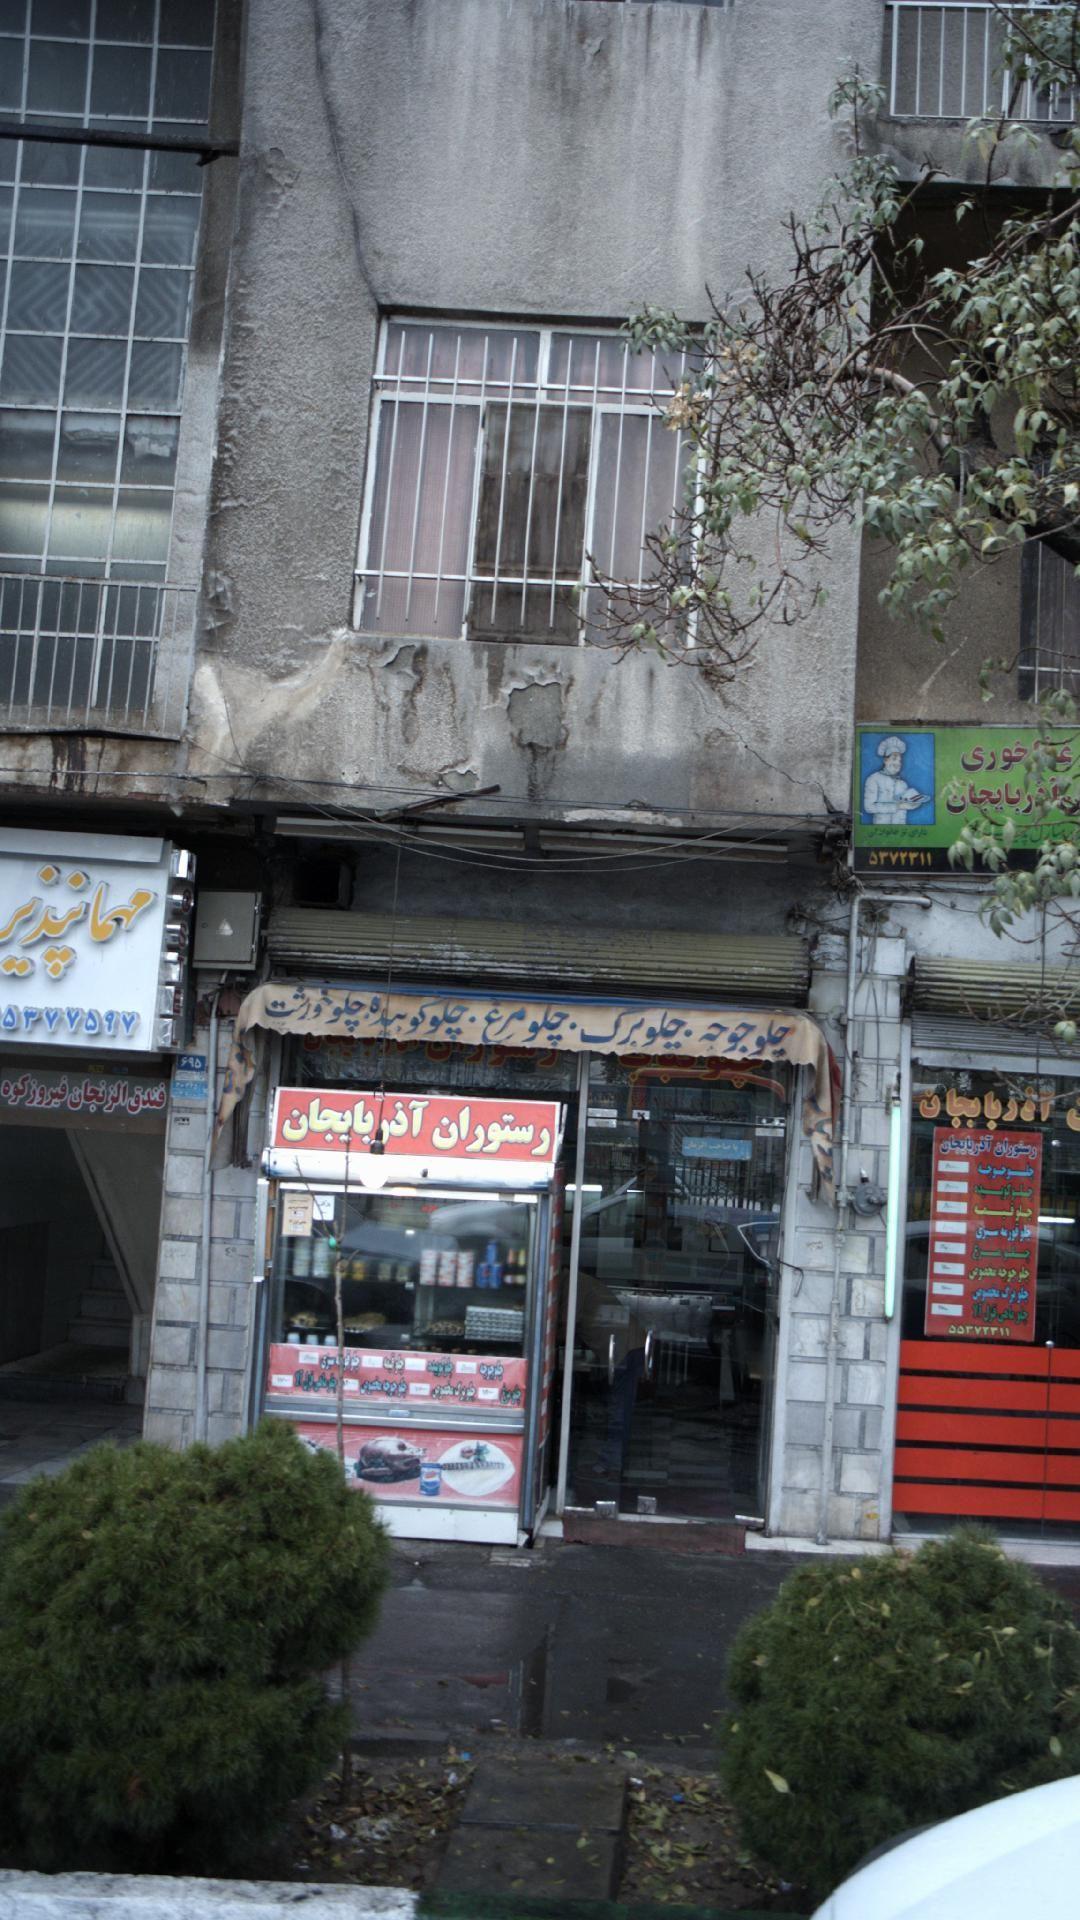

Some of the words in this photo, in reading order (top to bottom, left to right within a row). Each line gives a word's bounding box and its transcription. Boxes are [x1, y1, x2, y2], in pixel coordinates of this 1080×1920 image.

[521, 1004, 570, 1046] چلو
[641, 1010, 687, 1050] چلو
[699, 1021, 754, 1053] جوجه
[748, 1019, 793, 1058] چلو
[181, 1055, 202, 1069] ۶۹۵
[281, 1097, 430, 1146] آذربایجان
[431, 1103, 551, 1157] رستوران
[940, 1133, 994, 1157] آذربایجان
[993, 1137, 1038, 1160] رستوران
